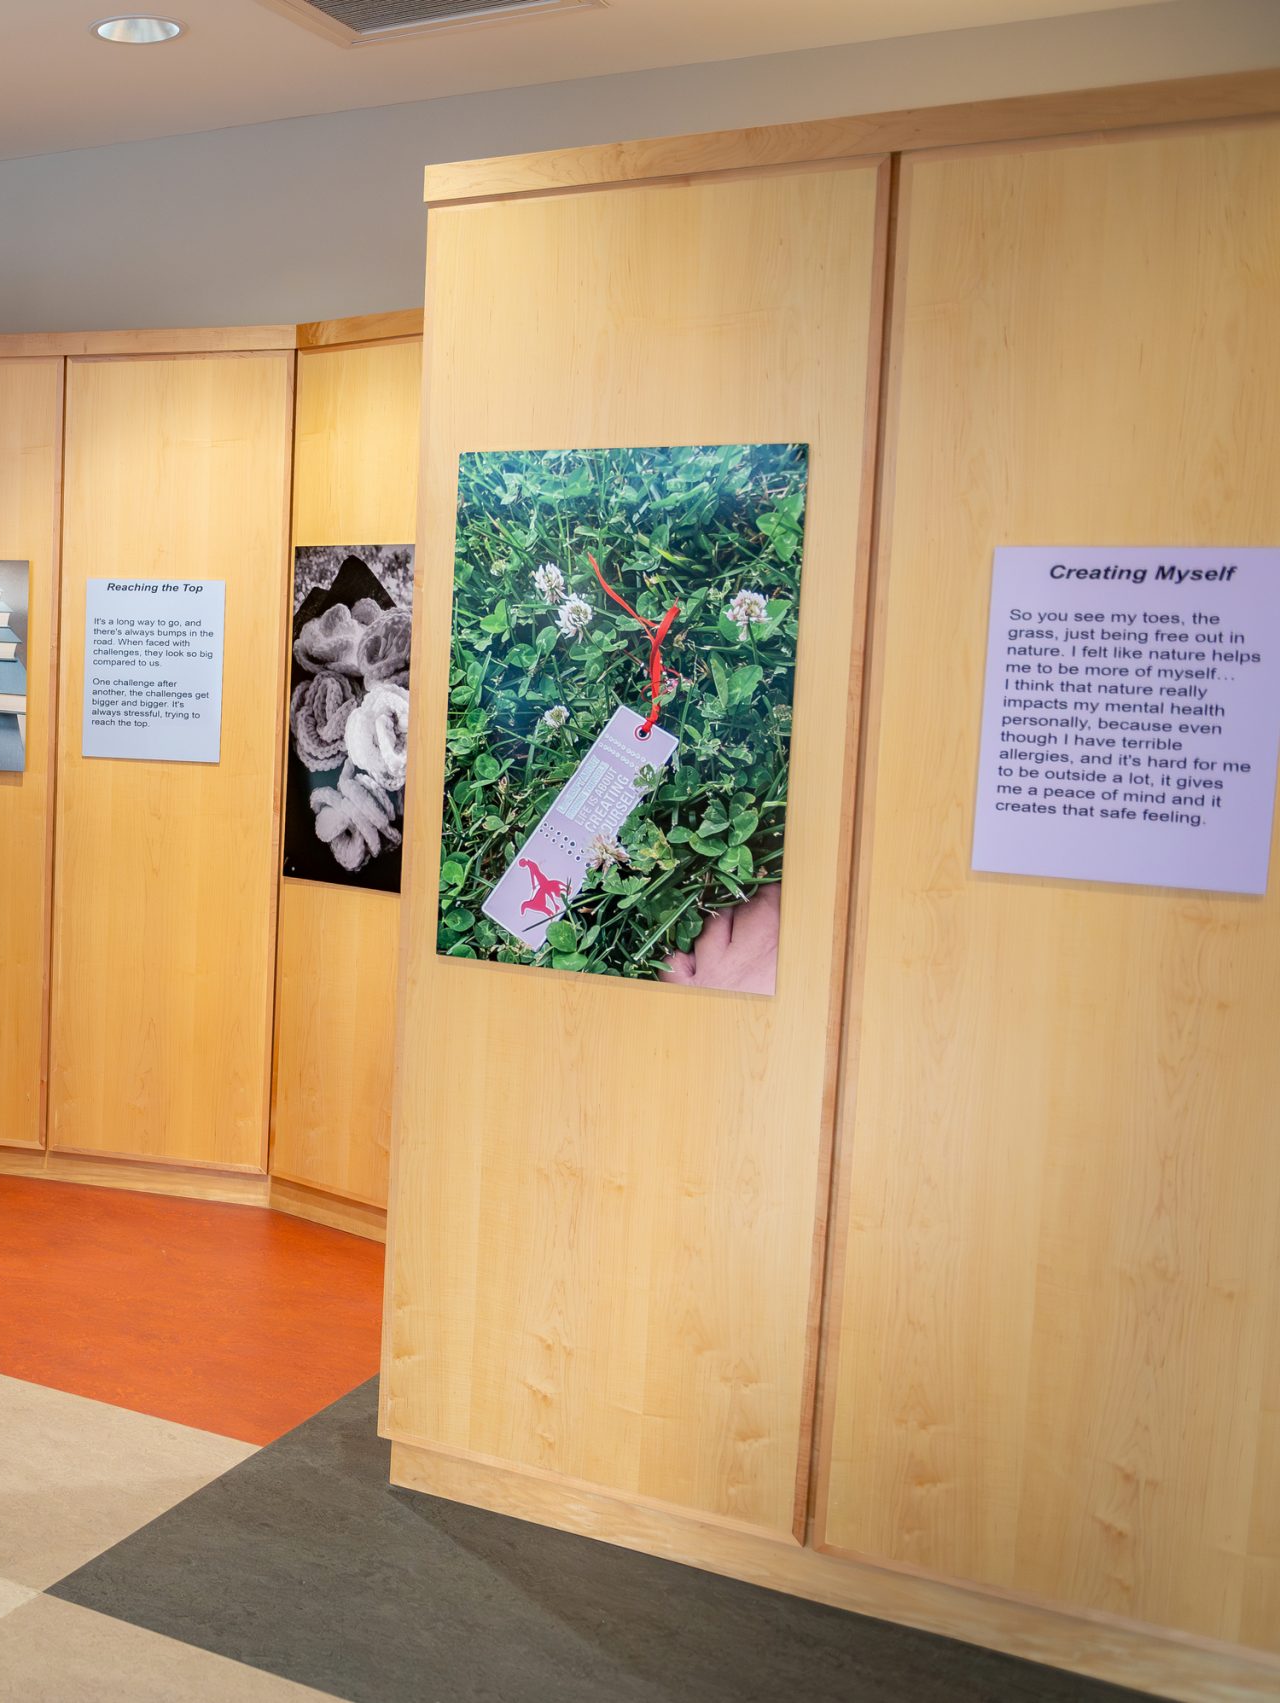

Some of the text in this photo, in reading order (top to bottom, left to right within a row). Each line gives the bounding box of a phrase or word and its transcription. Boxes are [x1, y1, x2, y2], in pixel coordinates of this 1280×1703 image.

[1050, 565, 1238, 584] Creating Myself
[107, 583, 203, 594] Reaching the Top
[94, 617, 106, 625] It's
[117, 618, 135, 627] long
[158, 619, 166, 627] to
[1010, 609, 1221, 626] So you see my toes, the
[125, 629, 155, 638] always
[157, 629, 187, 638] bumps
[1008, 628, 1245, 645] grass, just being free out in
[118, 638, 143, 646] When
[146, 639, 170, 647] faced
[93, 648, 142, 658] challenges,
[145, 649, 163, 658] they
[200, 651, 213, 660] big
[1007, 645, 1261, 665] nature. I felt like nature helps
[93, 659, 136, 667] compared
[1006, 664, 1031, 673] me
[1037, 663, 1053, 674] to
[1058, 663, 1079, 675] be
[1085, 666, 1129, 677] more
[1135, 665, 1153, 677] of
[113, 679, 155, 688] challenge
[157, 680, 177, 688] after
[1005, 679, 1208, 701] I think that nature really
[92, 689, 209, 700] another, the challenges get
[92, 698, 119, 708] bigger
[92, 709, 121, 718] always
[124, 710, 163, 718] stressful,
[165, 711, 189, 720] trying
[1003, 696, 1225, 717] impacts my mental health
[134, 720, 150, 728] top.
[1002, 716, 1222, 735] personally, because even
[1001, 731, 1183, 751] though I have terrible
[999, 748, 1252, 773] allergies, and it's hard for me
[998, 765, 1224, 791] to be outside a lot, it gives
[574, 807, 592, 826] LIFE
[587, 795, 598, 806] IS
[595, 766, 617, 797] ABOUT
[585, 774, 629, 833] CREATING
[997, 785, 1222, 808] me a peace of mind and it
[996, 802, 1206, 828] creates that safe feeling.
